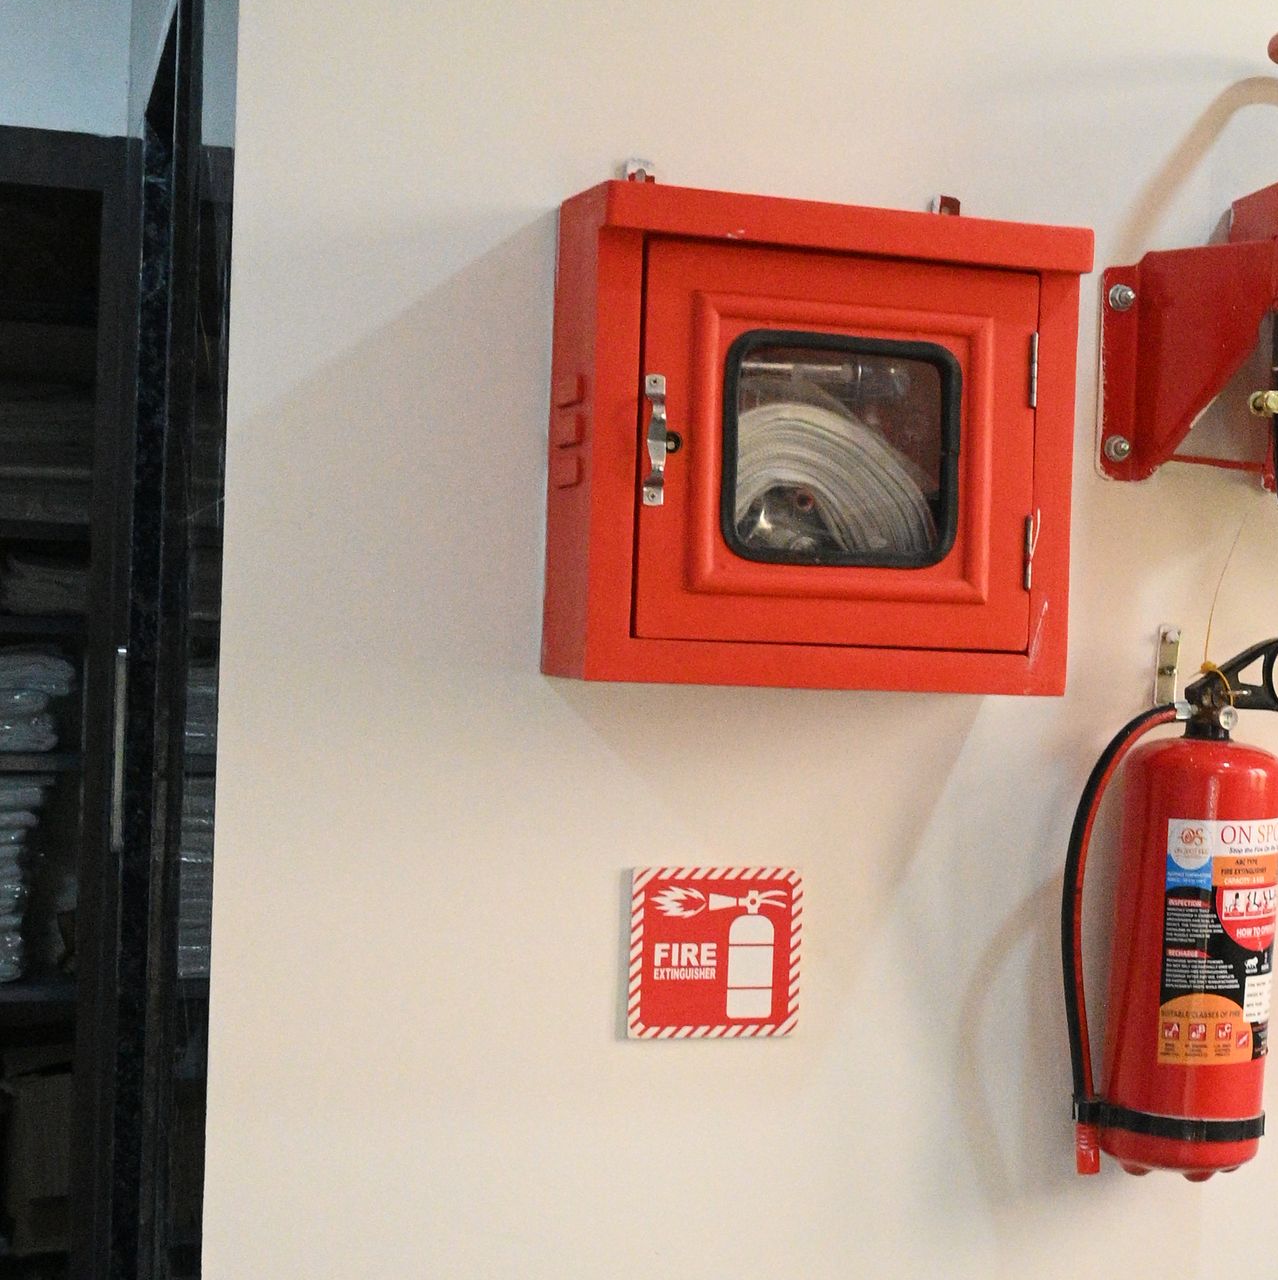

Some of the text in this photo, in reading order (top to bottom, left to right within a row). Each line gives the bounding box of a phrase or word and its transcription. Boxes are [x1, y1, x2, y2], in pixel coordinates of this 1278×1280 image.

[1221, 825, 1251, 845] ON
[1236, 928, 1252, 938] HOW
[654, 943, 717, 966] FIRE
[654, 967, 716, 980] EXTINGUISHER
[1172, 1023, 1179, 1032] A
